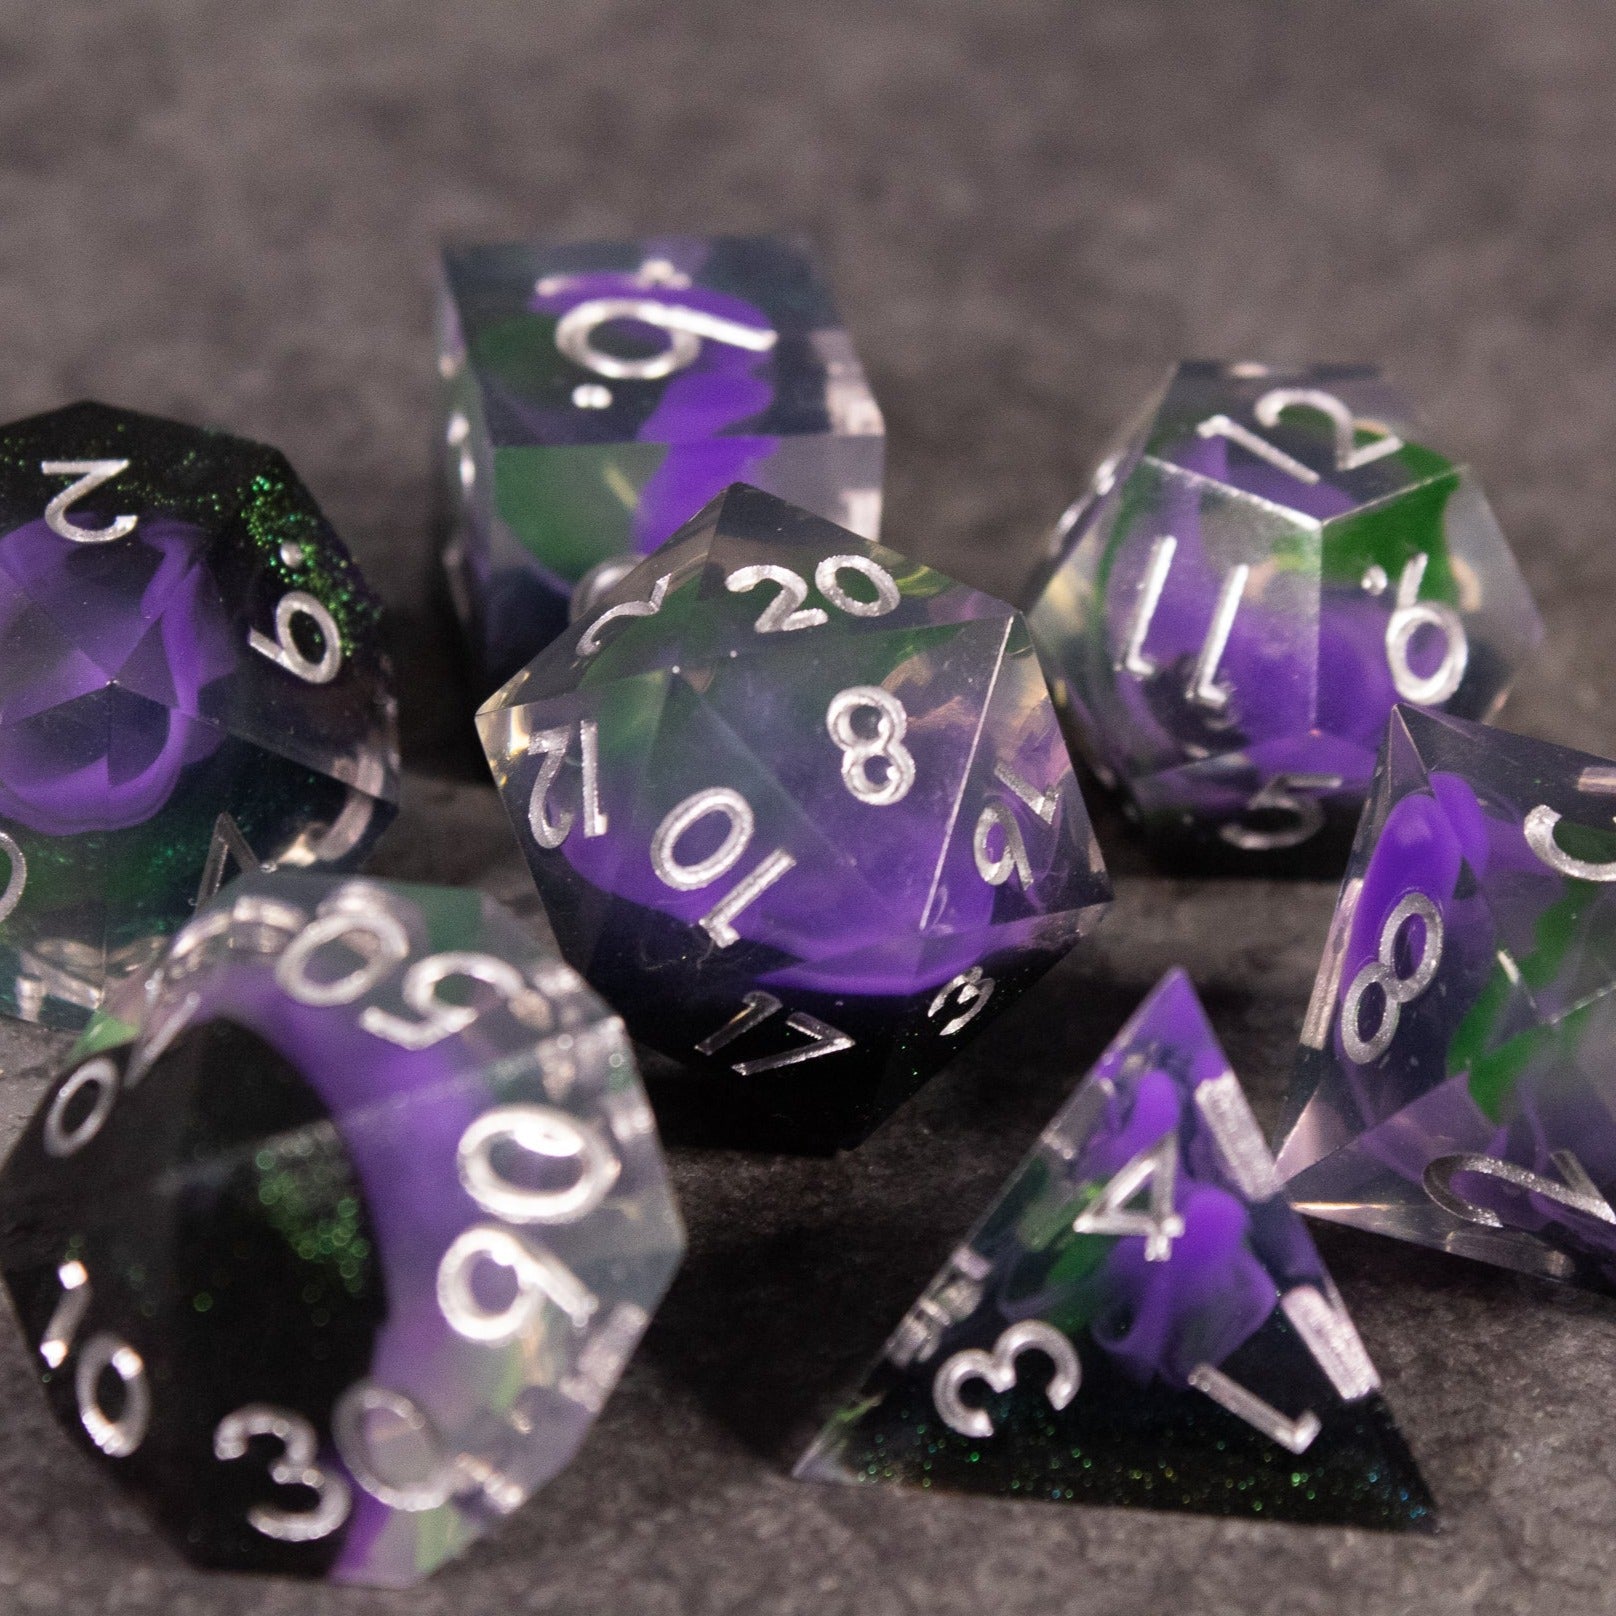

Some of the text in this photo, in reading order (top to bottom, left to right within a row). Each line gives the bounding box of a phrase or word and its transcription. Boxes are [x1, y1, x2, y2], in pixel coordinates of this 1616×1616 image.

[41, 459, 138, 542] 2
[1196, 389, 1404, 484] 12
[726, 555, 901, 634] 20
[528, 720, 609, 849] 12
[826, 685, 917, 806] 8
[650, 787, 796, 948] 10
[276, 909, 528, 1050] 50
[693, 990, 857, 1076] 17
[927, 966, 995, 1036] 3
[1341, 892, 1444, 1064] 8
[437, 1102, 620, 1343] 90
[1074, 1133, 1185, 1261] 4
[42, 1260, 150, 1457] 10
[932, 1319, 1082, 1438] 3
[214, 1376, 448, 1542] 30
